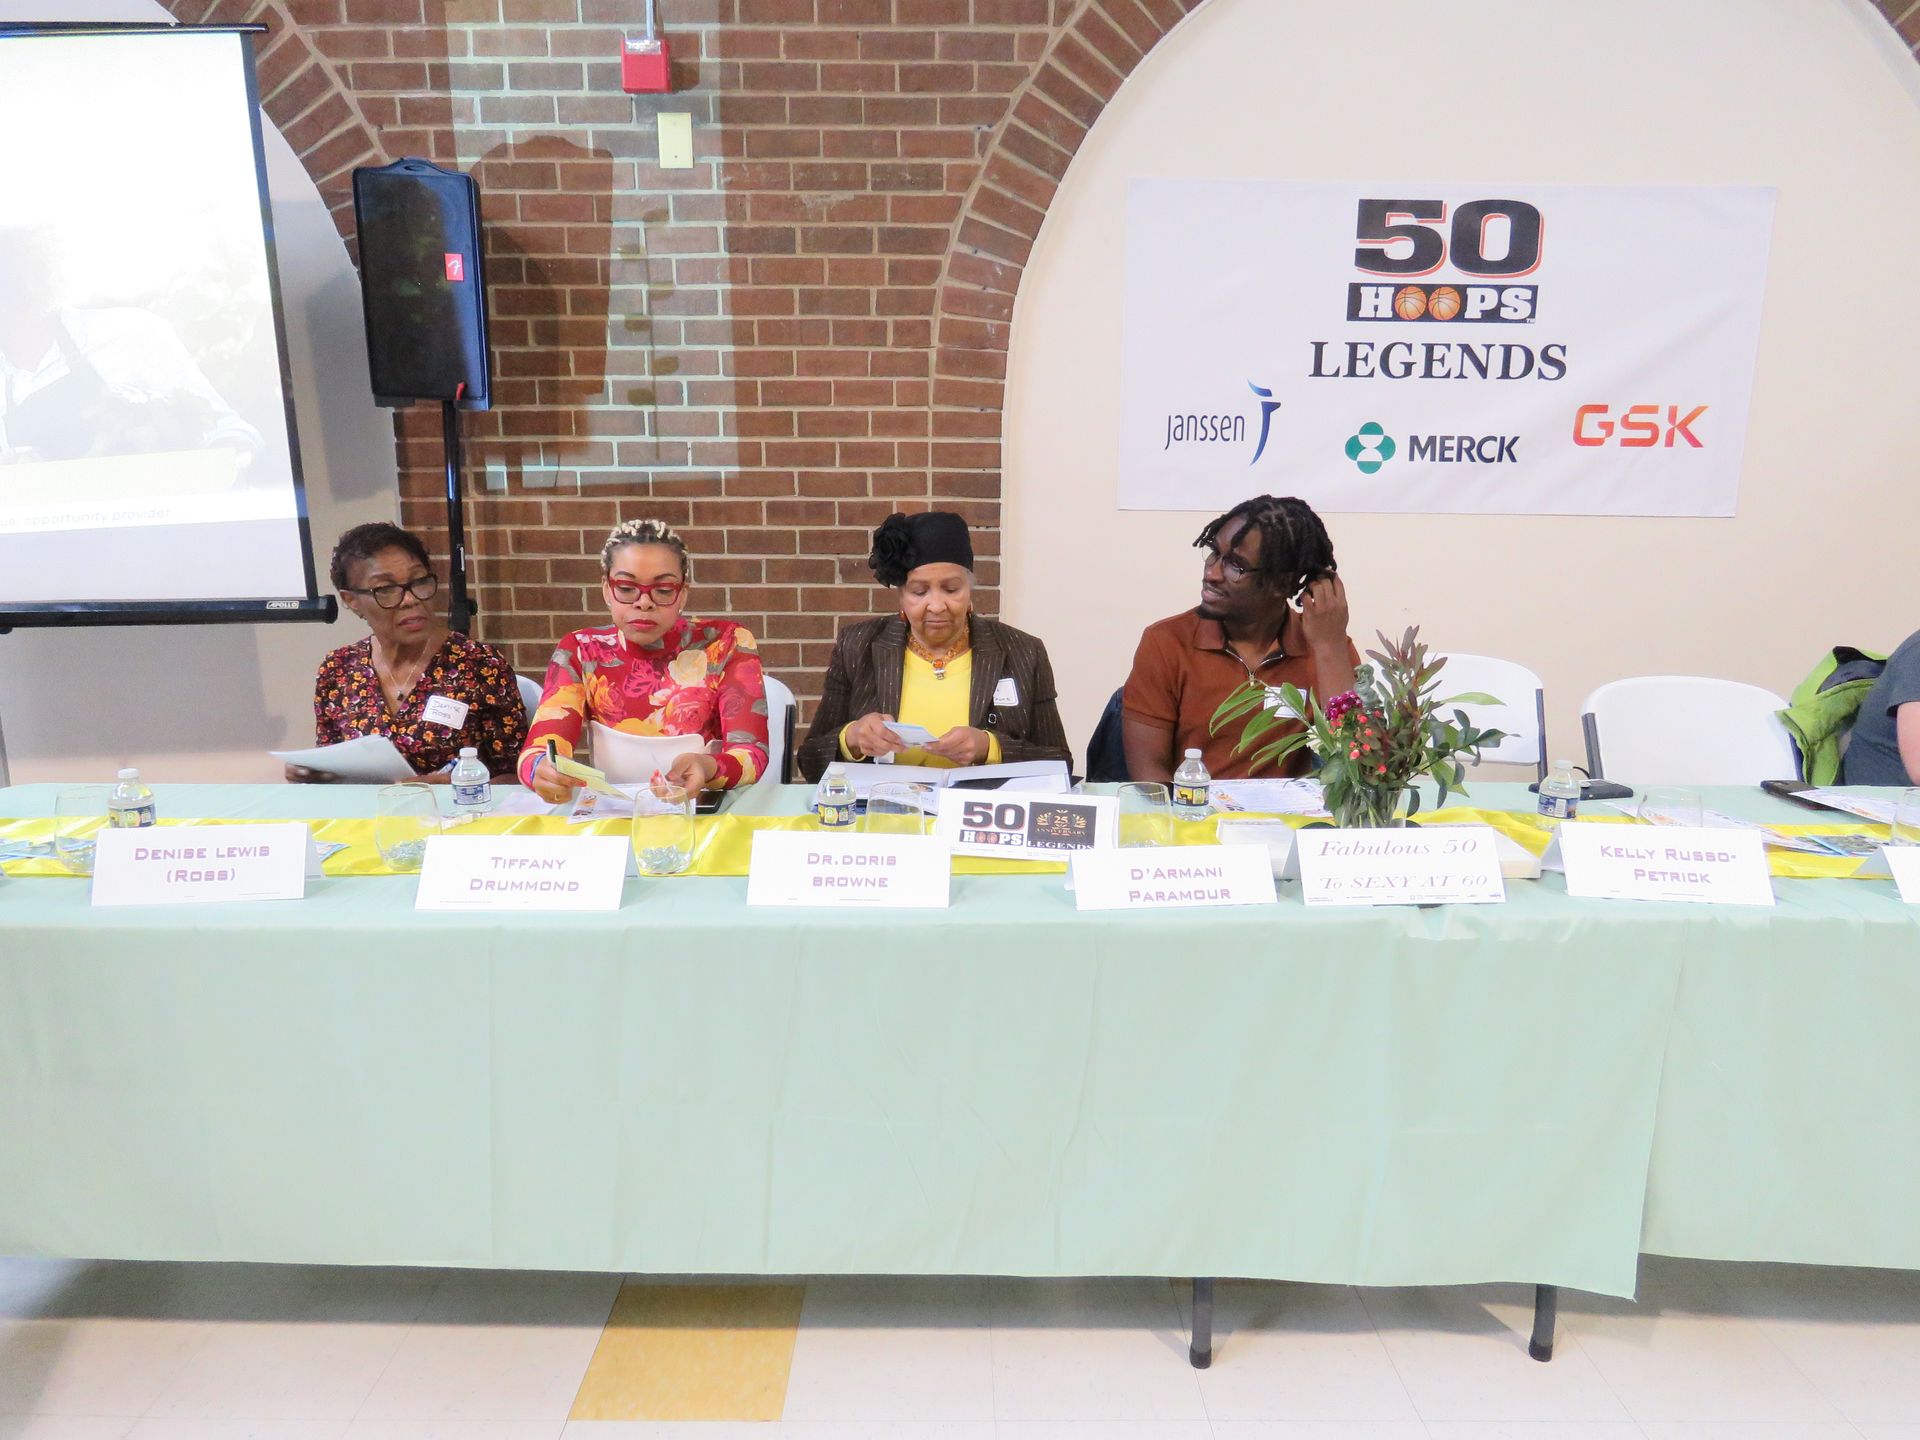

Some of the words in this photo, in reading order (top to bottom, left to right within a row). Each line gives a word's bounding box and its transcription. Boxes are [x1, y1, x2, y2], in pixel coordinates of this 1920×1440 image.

[1354, 198, 1545, 279] 50
[1358, 286, 1533, 321] HOOPS
[1308, 341, 1567, 381] LEGENDS
[1572, 403, 1709, 449] GSK
[1408, 435, 1521, 464] MERCK
[23, 511, 108, 528] opportunity
[962, 801, 1027, 831] 50
[1027, 839, 1096, 851] LEGENDS
[1318, 840, 1431, 856] Fabulous
[1443, 839, 1478, 854] 50
[1319, 876, 1343, 889] To
[1351, 875, 1416, 889] SEXY
[1423, 874, 1458, 888] AT
[1463, 873, 1489, 887] 60
